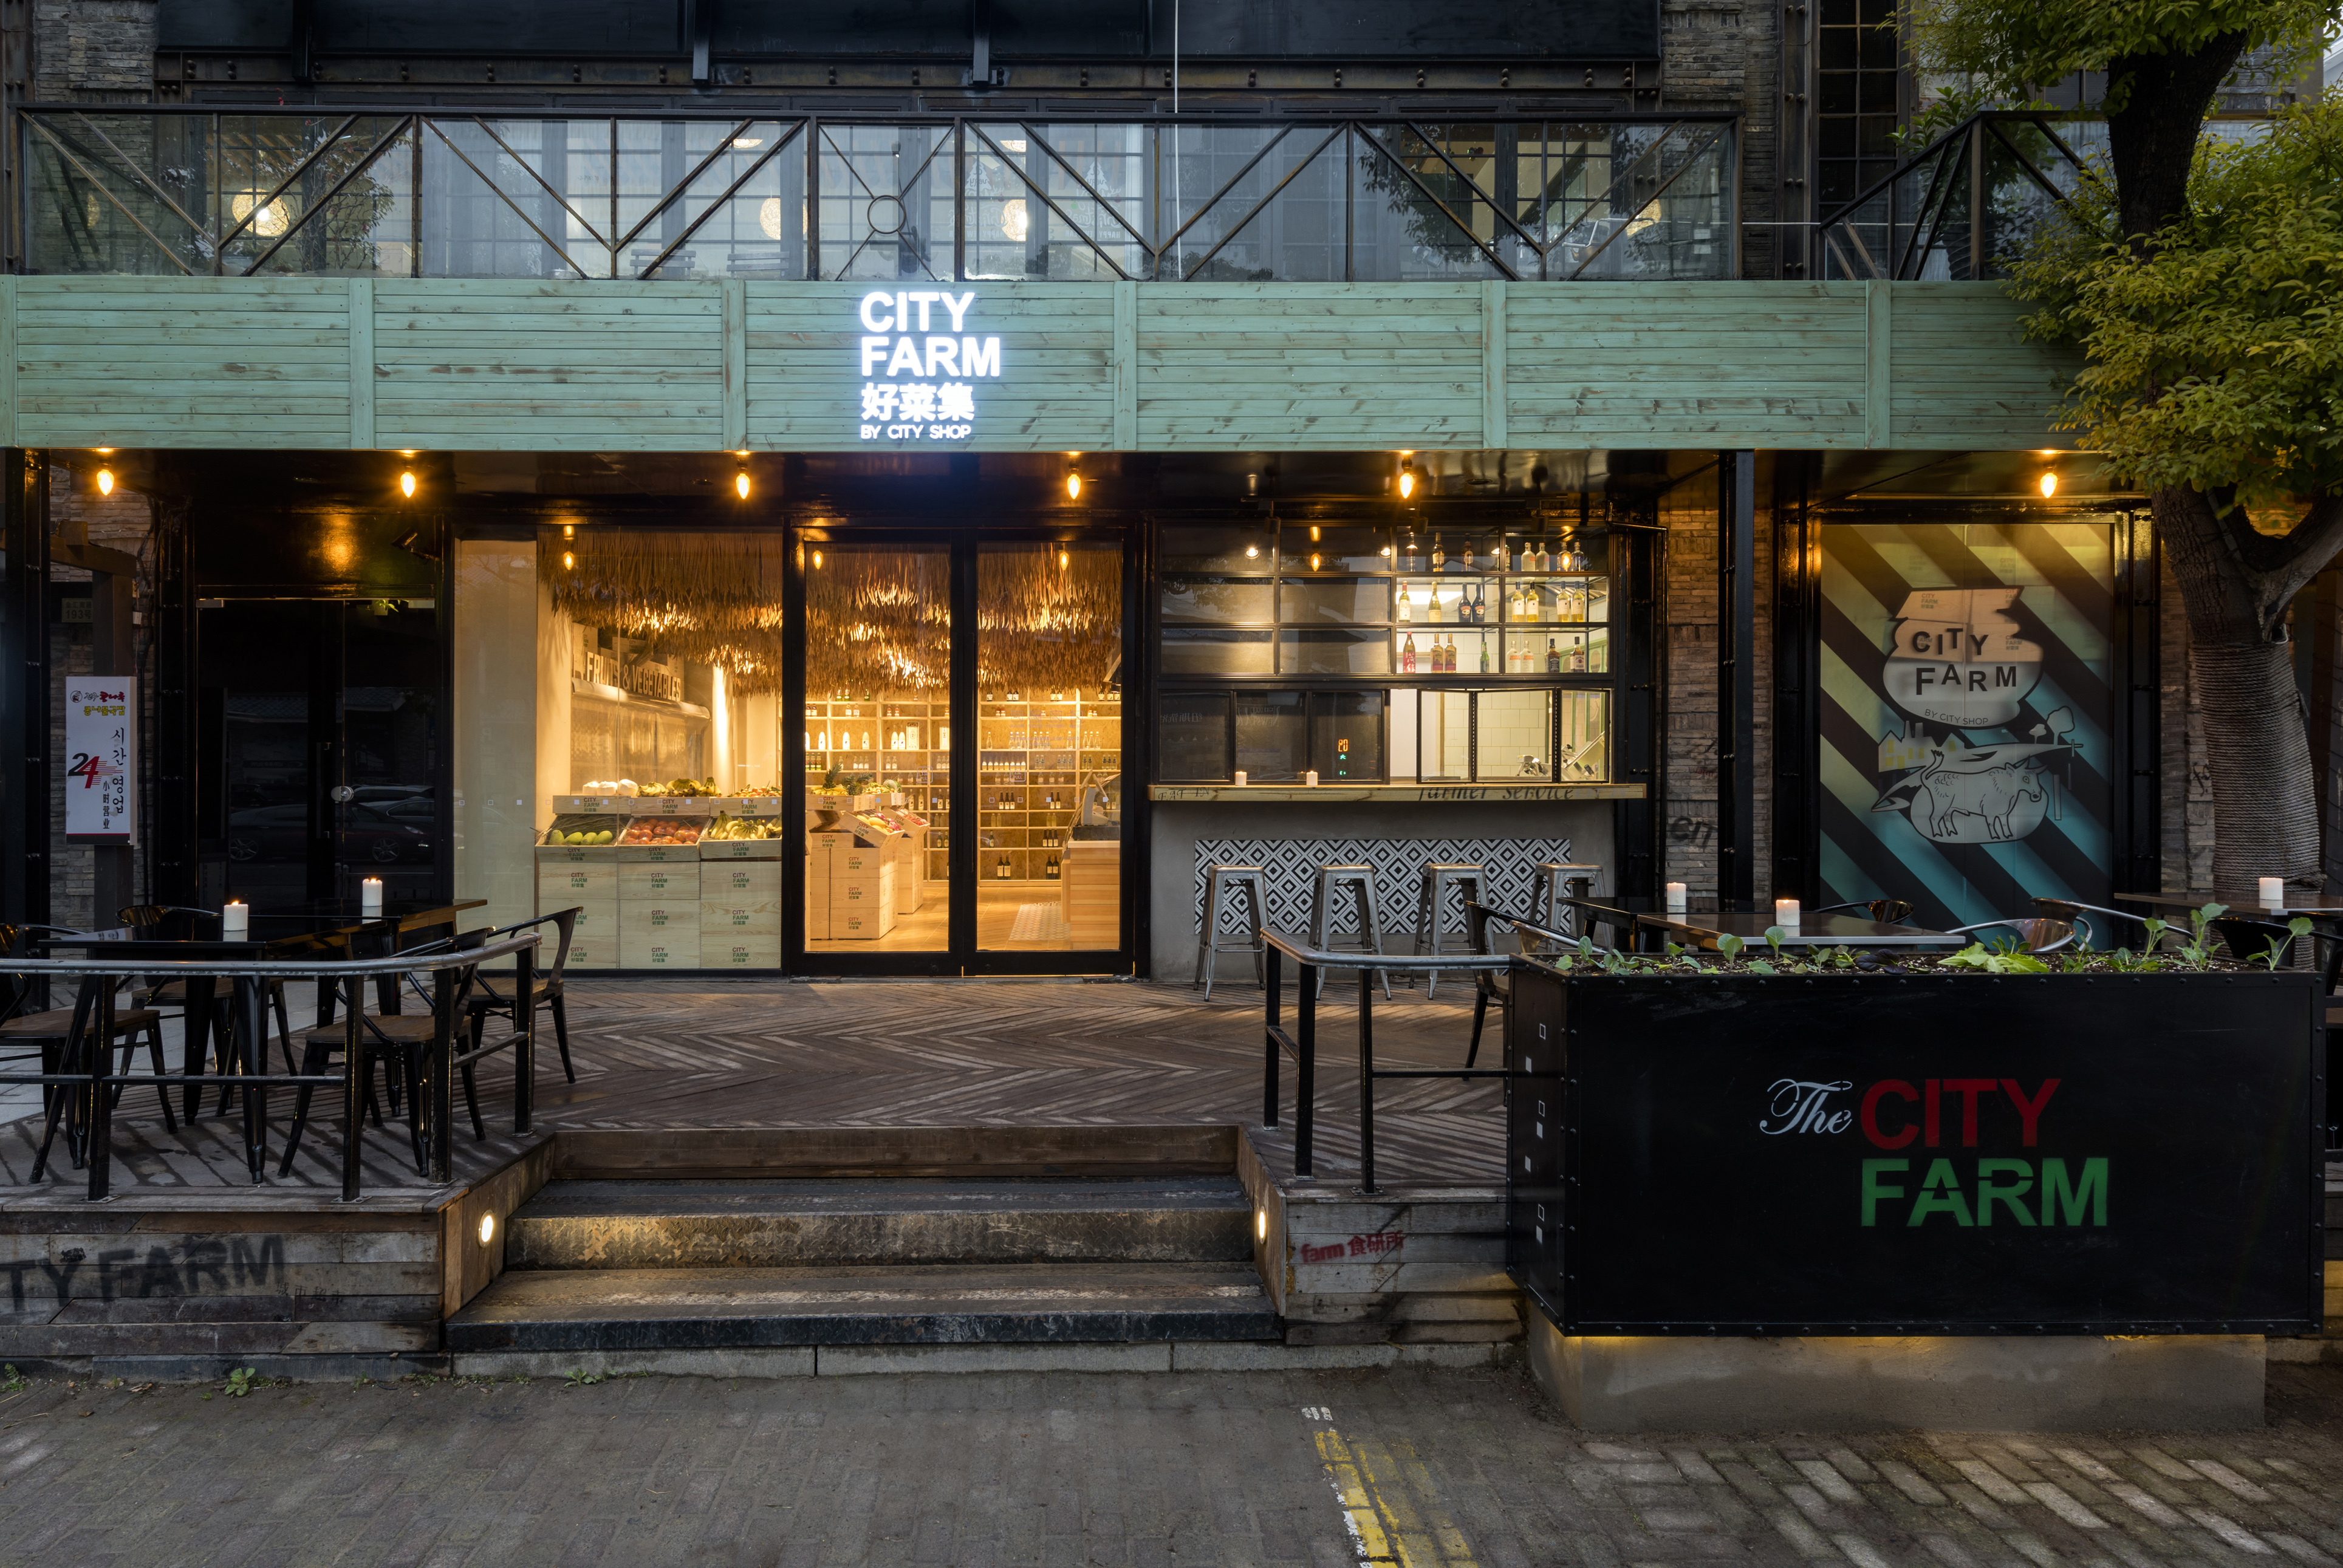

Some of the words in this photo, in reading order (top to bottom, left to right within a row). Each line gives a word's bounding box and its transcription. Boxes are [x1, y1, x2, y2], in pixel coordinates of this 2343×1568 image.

[861, 292, 975, 332] CITY
[861, 337, 1000, 377] FARM
[861, 382, 974, 422] 好菜集
[861, 425, 881, 439] BY
[888, 425, 924, 439] CITY
[929, 425, 971, 439] SHOP
[66, 610, 92, 619] 193号
[1912, 628, 1989, 656] CITY
[586, 651, 618, 688] FRUITS
[623, 664, 630, 690] &
[632, 665, 681, 702] VEGETABLES
[1915, 664, 2017, 695] FARM
[84, 706, 125, 716] 콩나물국밥
[1924, 708, 1938, 718] BY
[1940, 713, 1961, 724] CITY
[67, 753, 100, 789] 24
[857, 826, 869, 835] FARM
[1760, 1079, 1853, 1135] The
[1861, 1078, 2062, 1149] CITY
[1861, 1158, 2109, 1227] FARM
[98, 1234, 285, 1303] FARM
